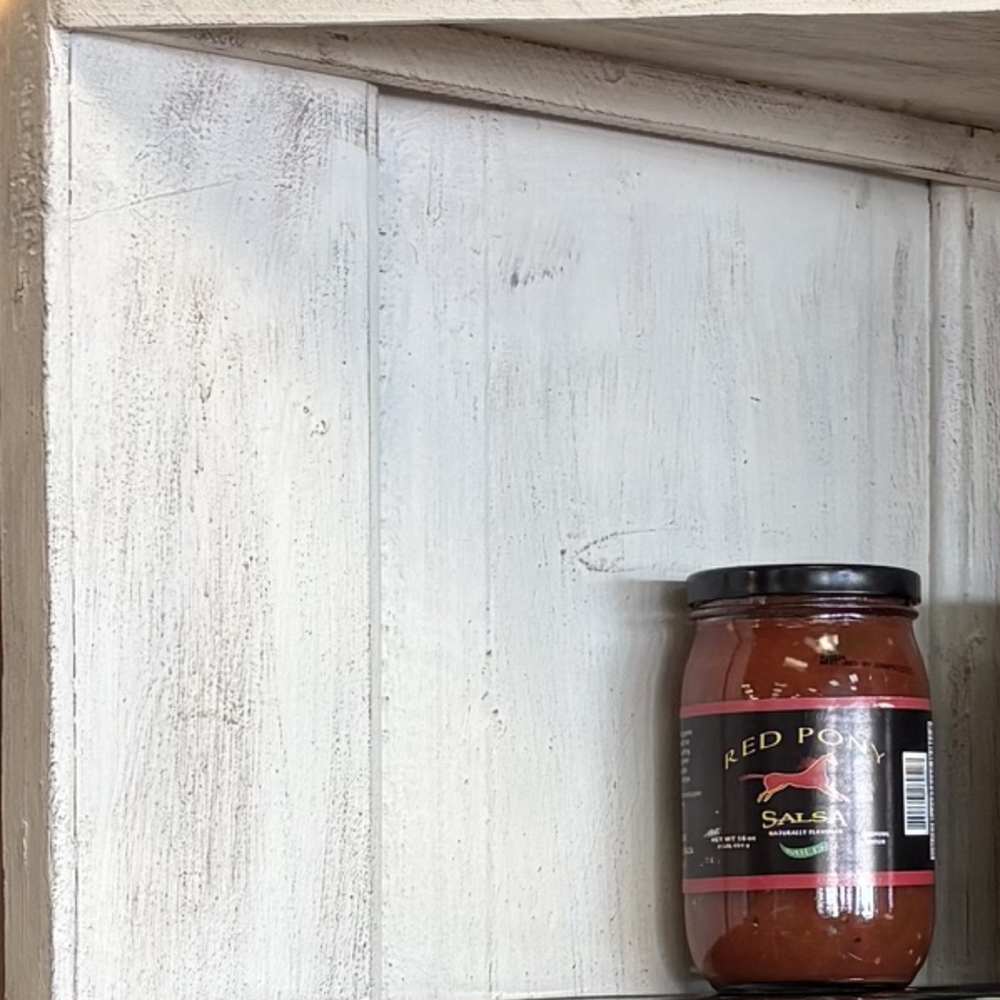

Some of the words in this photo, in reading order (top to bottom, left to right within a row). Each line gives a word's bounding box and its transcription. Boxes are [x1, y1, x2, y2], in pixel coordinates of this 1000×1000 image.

[724, 728, 783, 770] RED
[798, 727, 886, 764] PONY
[762, 809, 849, 830] SALSA
